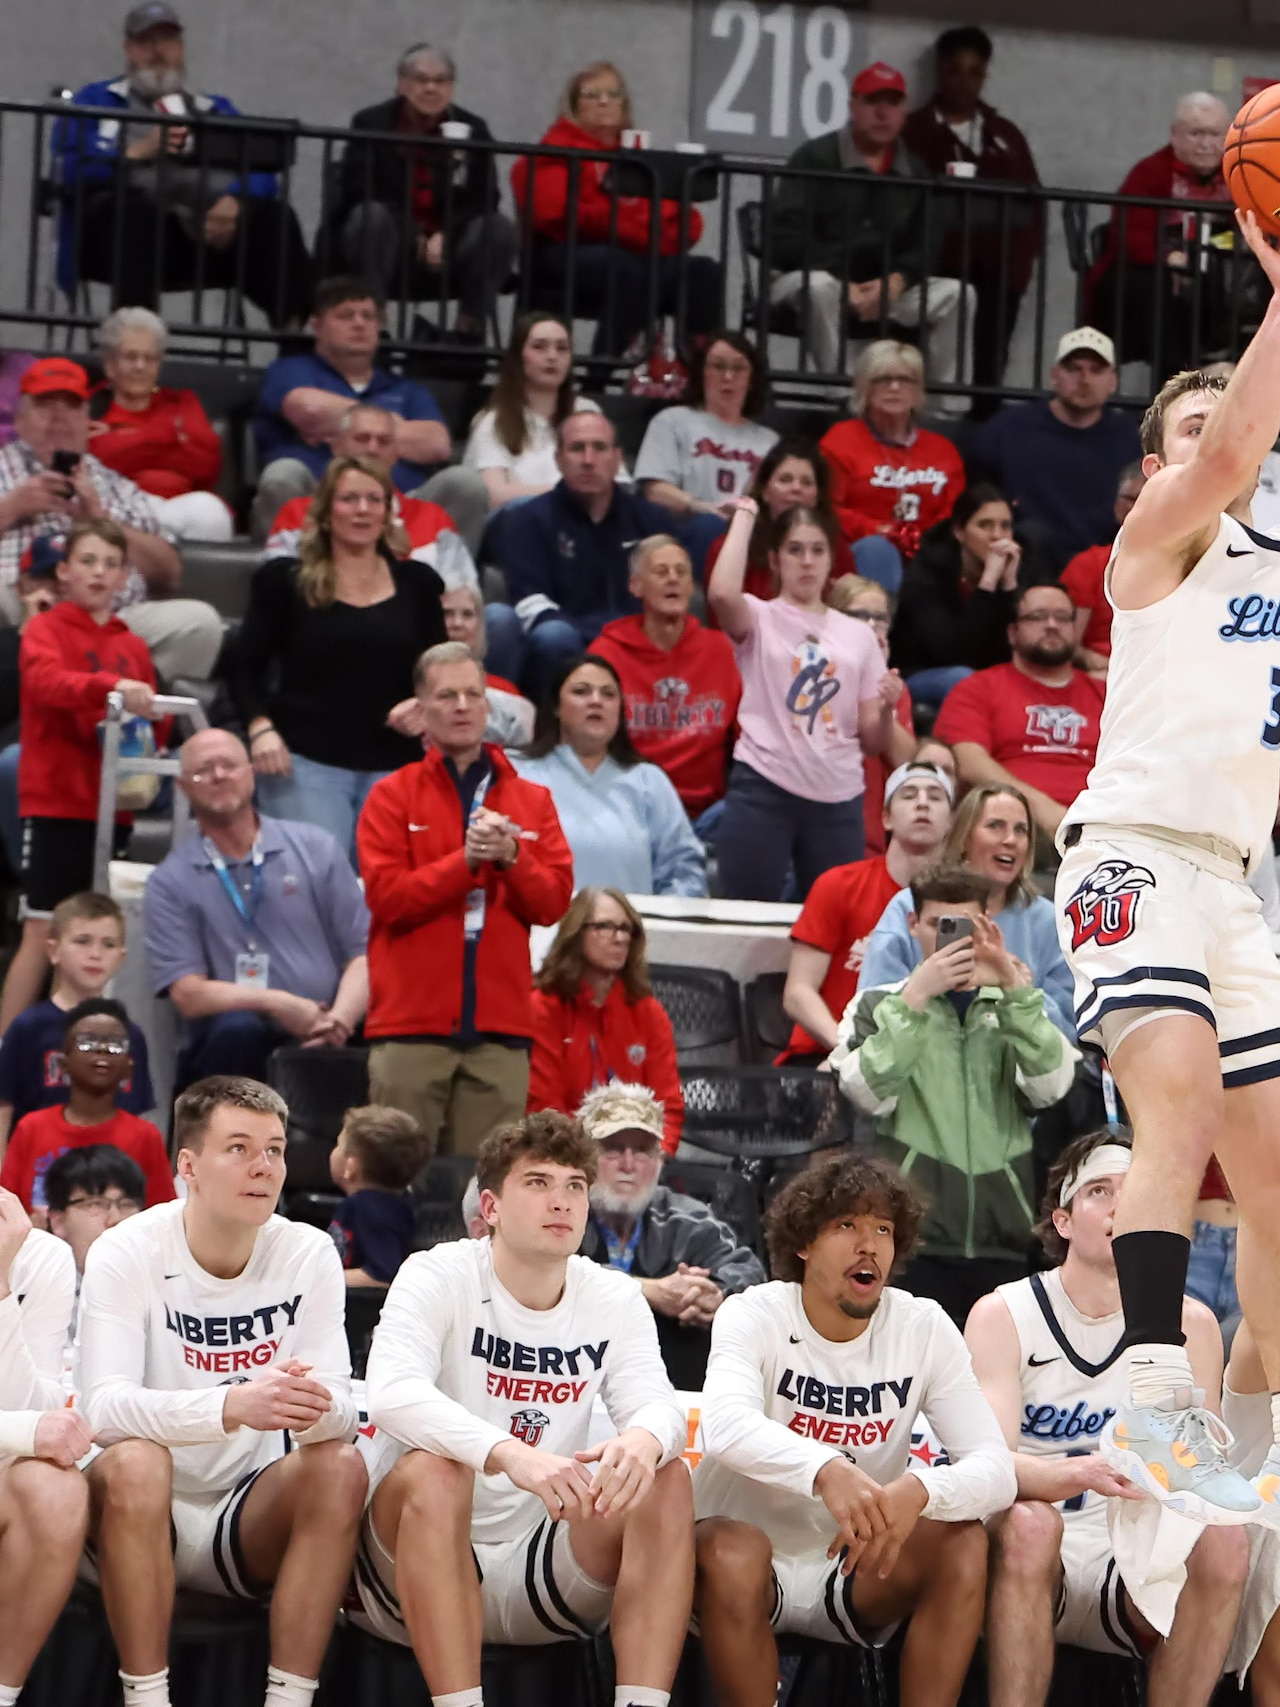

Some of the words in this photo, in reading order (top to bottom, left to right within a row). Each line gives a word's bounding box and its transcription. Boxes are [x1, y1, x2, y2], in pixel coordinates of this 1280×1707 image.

[706, 0, 851, 139] 218
[869, 465, 948, 495] Liberty
[1064, 889, 1141, 954] LU
[163, 1294, 303, 1346] LIBERTY
[181, 1335, 284, 1373] ENERGY
[470, 1326, 610, 1376] LIBERTY
[486, 1370, 589, 1404] ENERGY
[776, 1368, 914, 1417] LIBERTY
[787, 1411, 896, 1447] ENERGY
[1021, 1400, 1117, 1441] Liber
